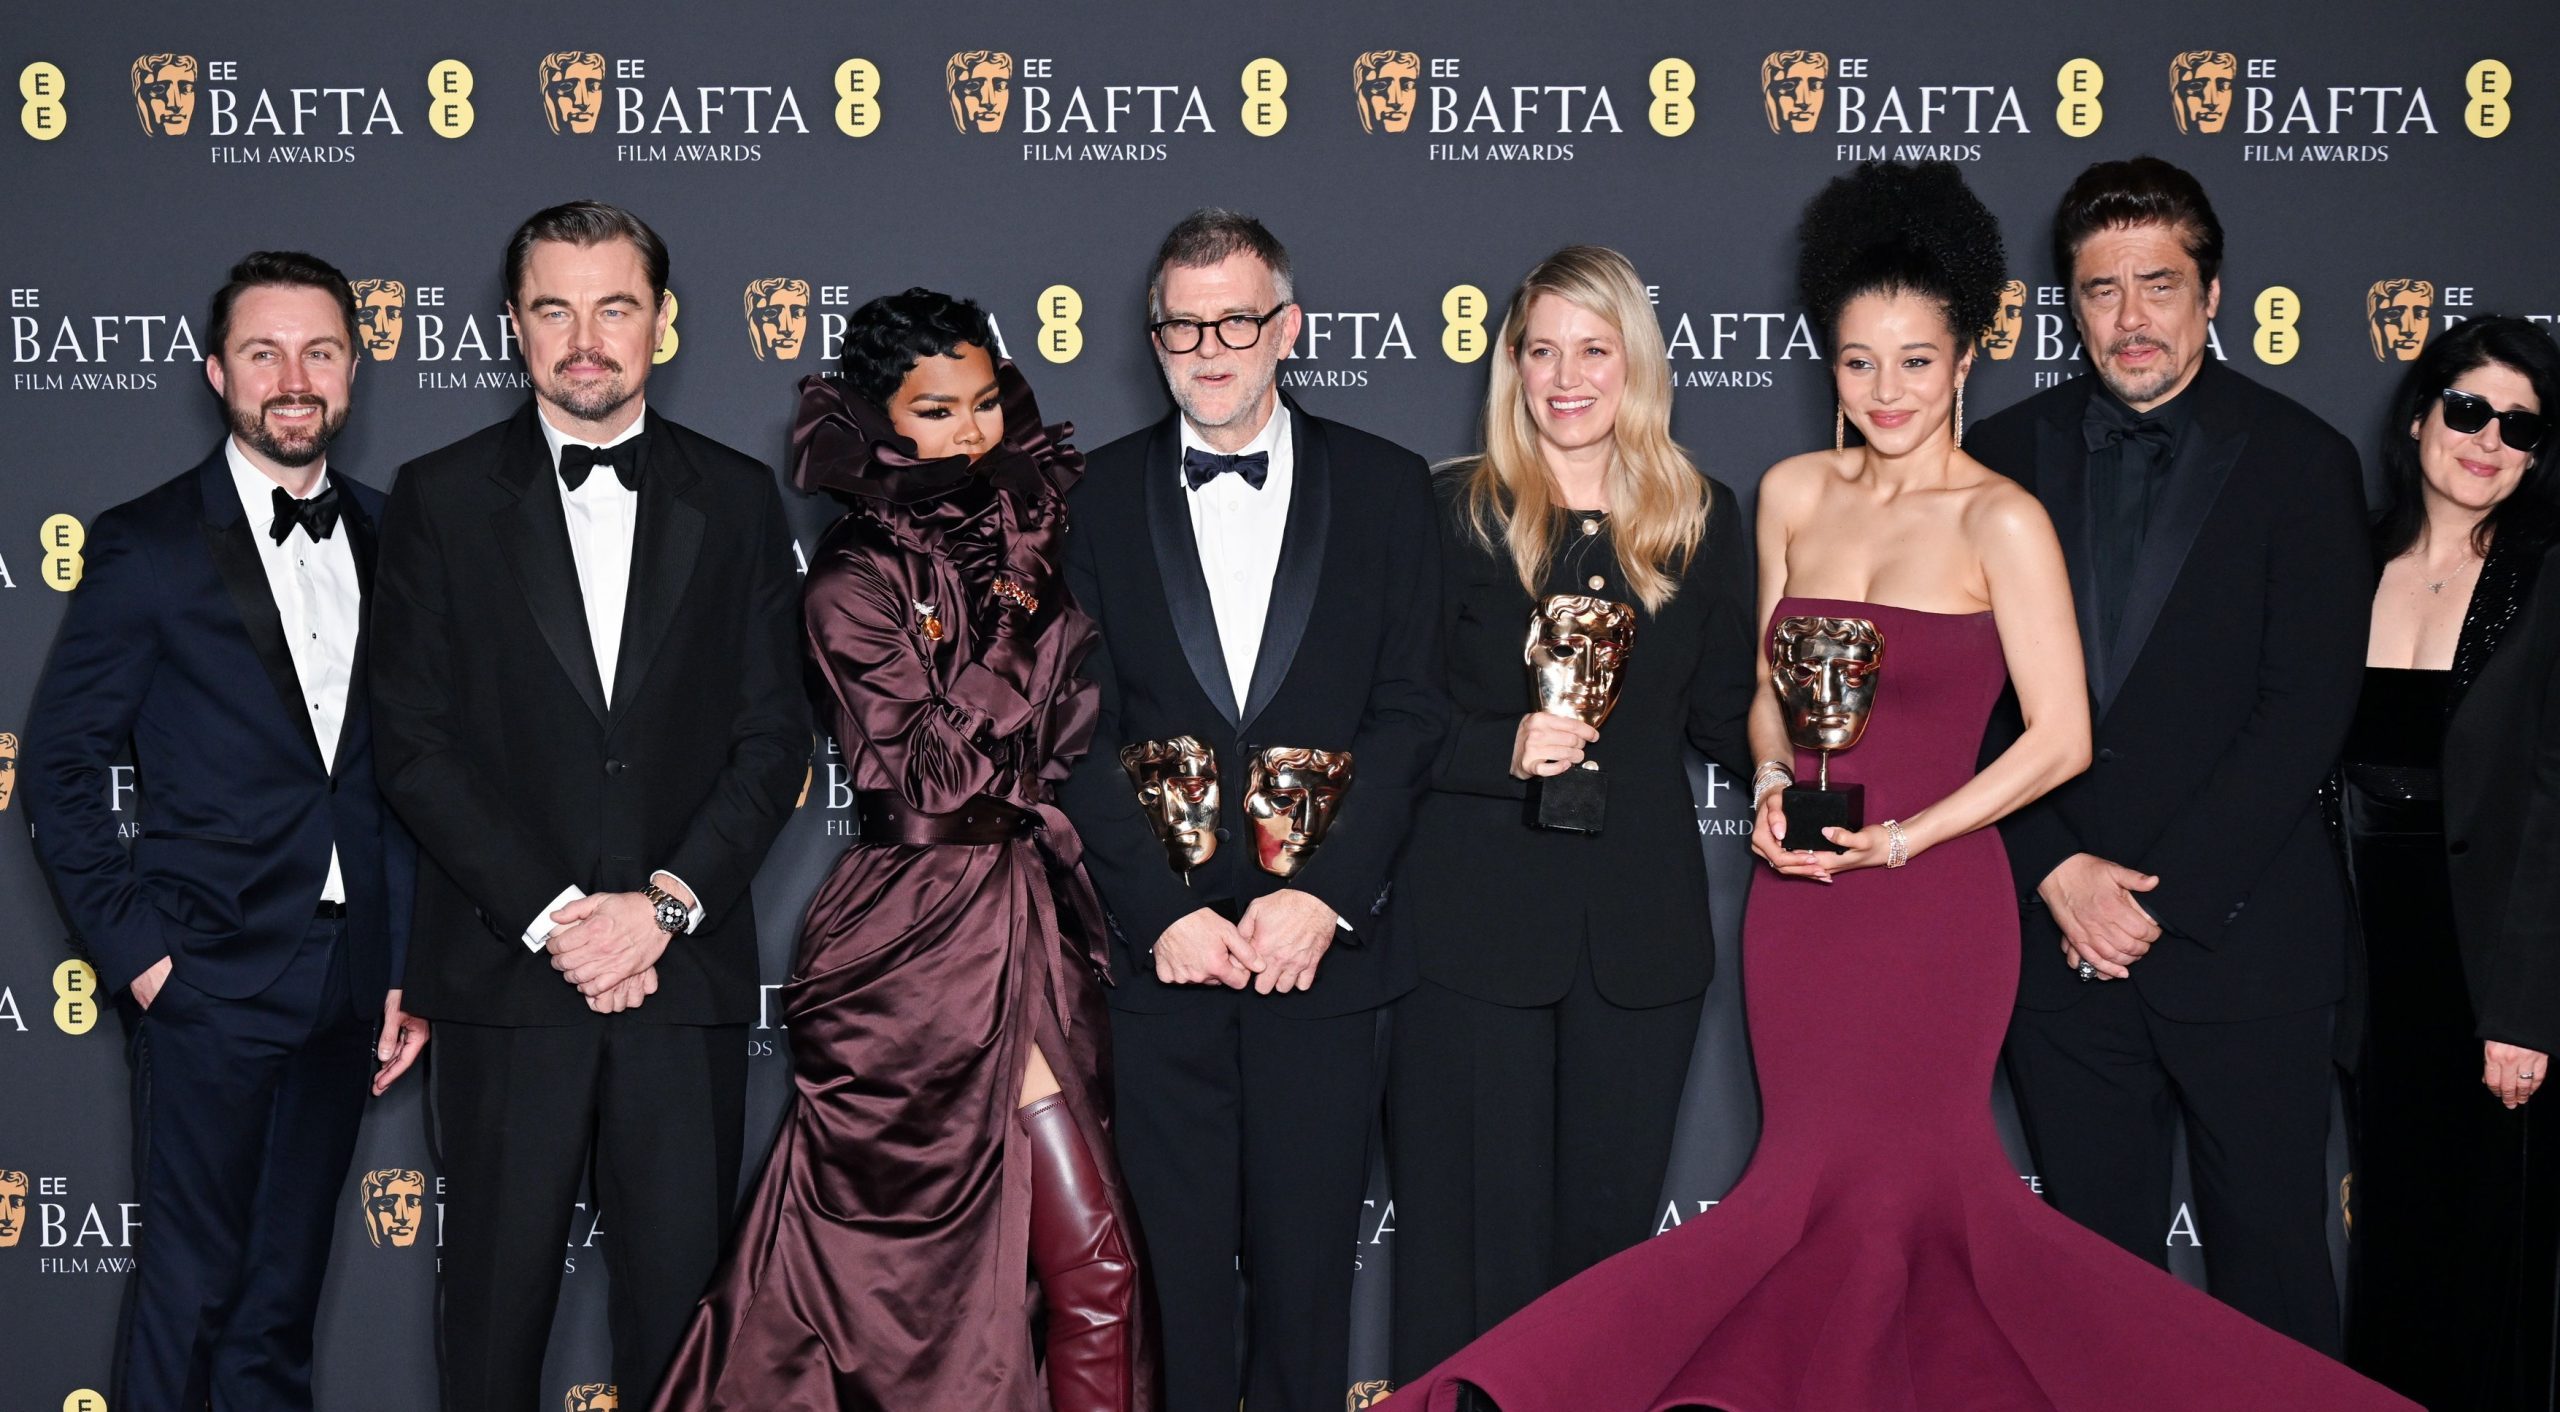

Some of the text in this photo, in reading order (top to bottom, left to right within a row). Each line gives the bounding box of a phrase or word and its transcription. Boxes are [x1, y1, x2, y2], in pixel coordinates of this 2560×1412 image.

[208, 61, 238, 81] EE
[616, 59, 646, 79] EE
[1023, 58, 1053, 78] EE
[1431, 58, 1460, 78] EE
[1839, 58, 1869, 78] EE
[2247, 59, 2277, 78] EE
[208, 87, 404, 136] BAFTA
[615, 86, 810, 134] BAFTA
[1022, 85, 1217, 134] BAFTA
[1428, 85, 1624, 133] BAFTA
[1836, 85, 2031, 134] BAFTA
[2244, 86, 2439, 134] BAFTA
[211, 146, 355, 164] FILM AWARDS
[617, 144, 761, 162] FILM AWARDS
[1023, 144, 1167, 161] FILM AWARDS
[1429, 144, 1574, 161] FILM AWARDS
[1837, 144, 1981, 162] FILM AWARDS
[2244, 145, 2389, 162] FILM AWARDS
[11, 288, 40, 308] EE
[416, 286, 445, 306] EE
[821, 285, 850, 305] EE
[2037, 286, 2066, 306] EE
[2444, 287, 2474, 306] EE
[10, 315, 205, 363] BAFTA
[415, 313, 518, 362] BAF
[1287, 312, 1417, 360] FTA
[1666, 312, 1822, 360] AFTA
[14, 373, 157, 390] FILM AWARDS
[418, 372, 533, 389] FILM AWAR
[1281, 370, 1368, 387] AWARDS
[1685, 370, 1773, 388] AWARDS
[827, 820, 861, 836] FIL
[1697, 819, 1754, 836] WARD
[39, 1177, 68, 1195] EE
[39, 1202, 143, 1248] BAF
[41, 1257, 137, 1273] FILM AWA
